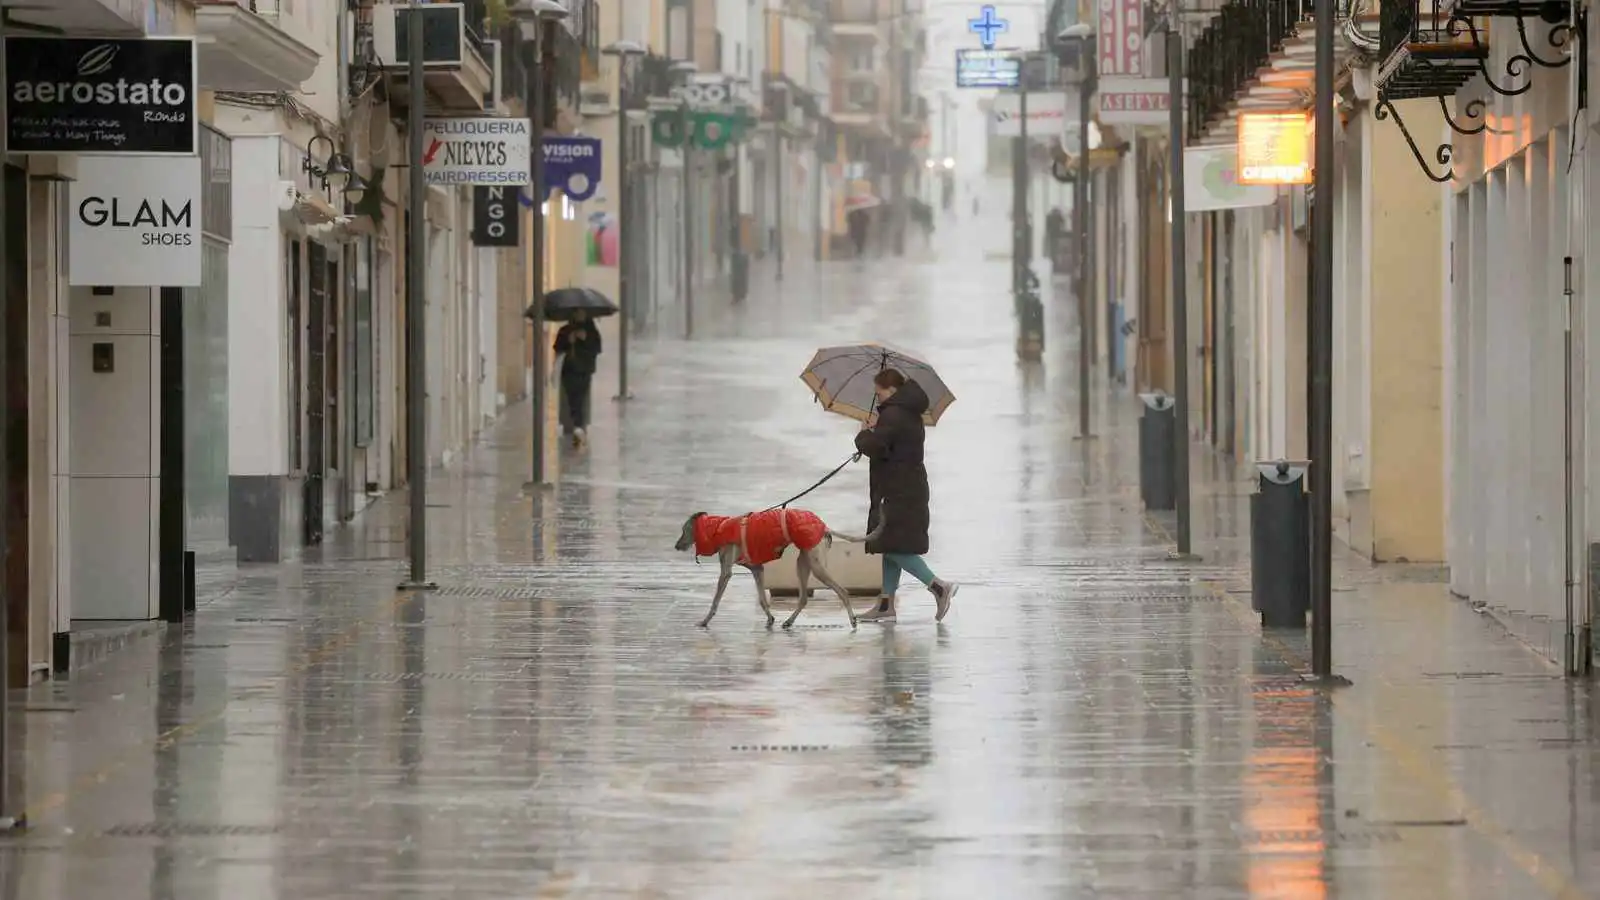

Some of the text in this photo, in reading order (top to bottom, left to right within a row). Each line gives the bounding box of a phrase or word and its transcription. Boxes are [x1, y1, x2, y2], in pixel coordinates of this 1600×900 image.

[13, 78, 186, 105] aerostato
[144, 111, 186, 122] Ronda
[424, 121, 526, 134] PELUQUERIA
[444, 140, 507, 166] NIEVES
[424, 171, 527, 183] HAIRDRESSER
[79, 197, 192, 228] GLAM
[142, 233, 192, 246] SHOES
